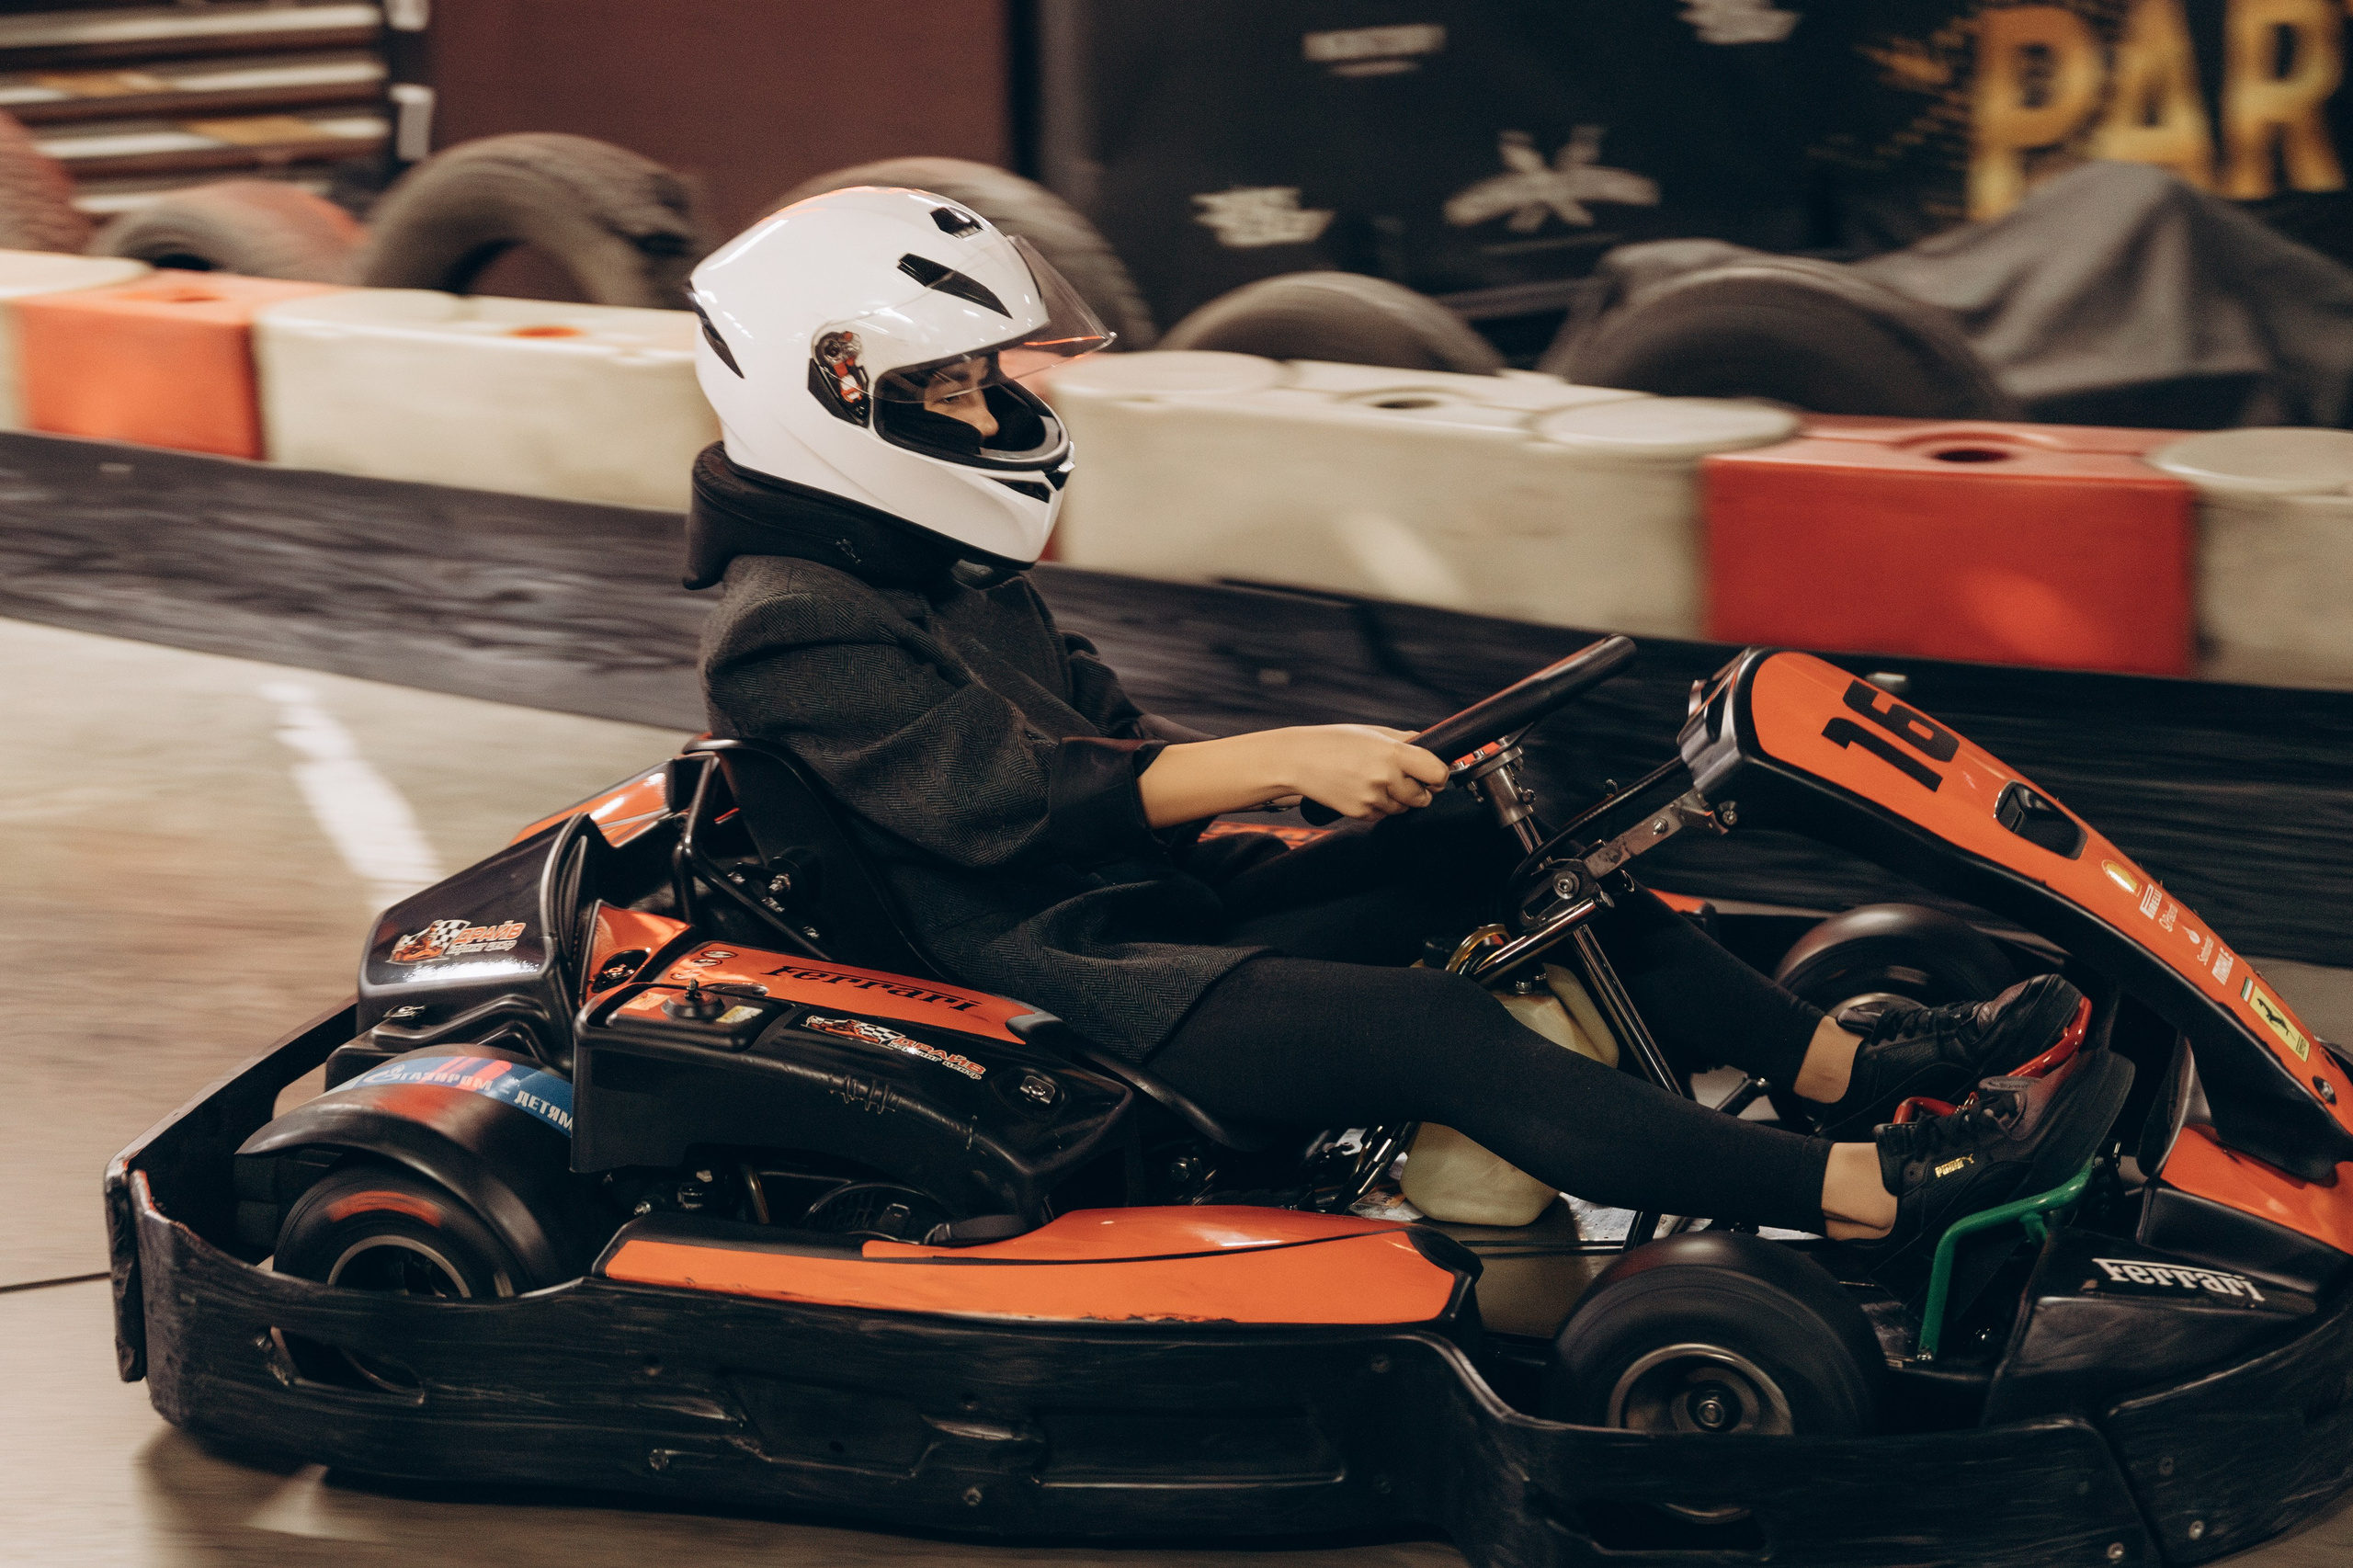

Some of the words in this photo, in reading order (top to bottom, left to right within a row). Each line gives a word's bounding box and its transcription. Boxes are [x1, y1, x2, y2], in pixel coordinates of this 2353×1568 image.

[1967, 0, 2353, 221] PAR
[1821, 678, 1960, 793] 16
[451, 919, 527, 944] ДРАЙВ
[761, 965, 983, 1013] Ferrari
[890, 1037, 987, 1075] ДРАЙВ
[513, 1089, 574, 1131] ДЕТЯМ
[2091, 1257, 2266, 1302] Ferrari
